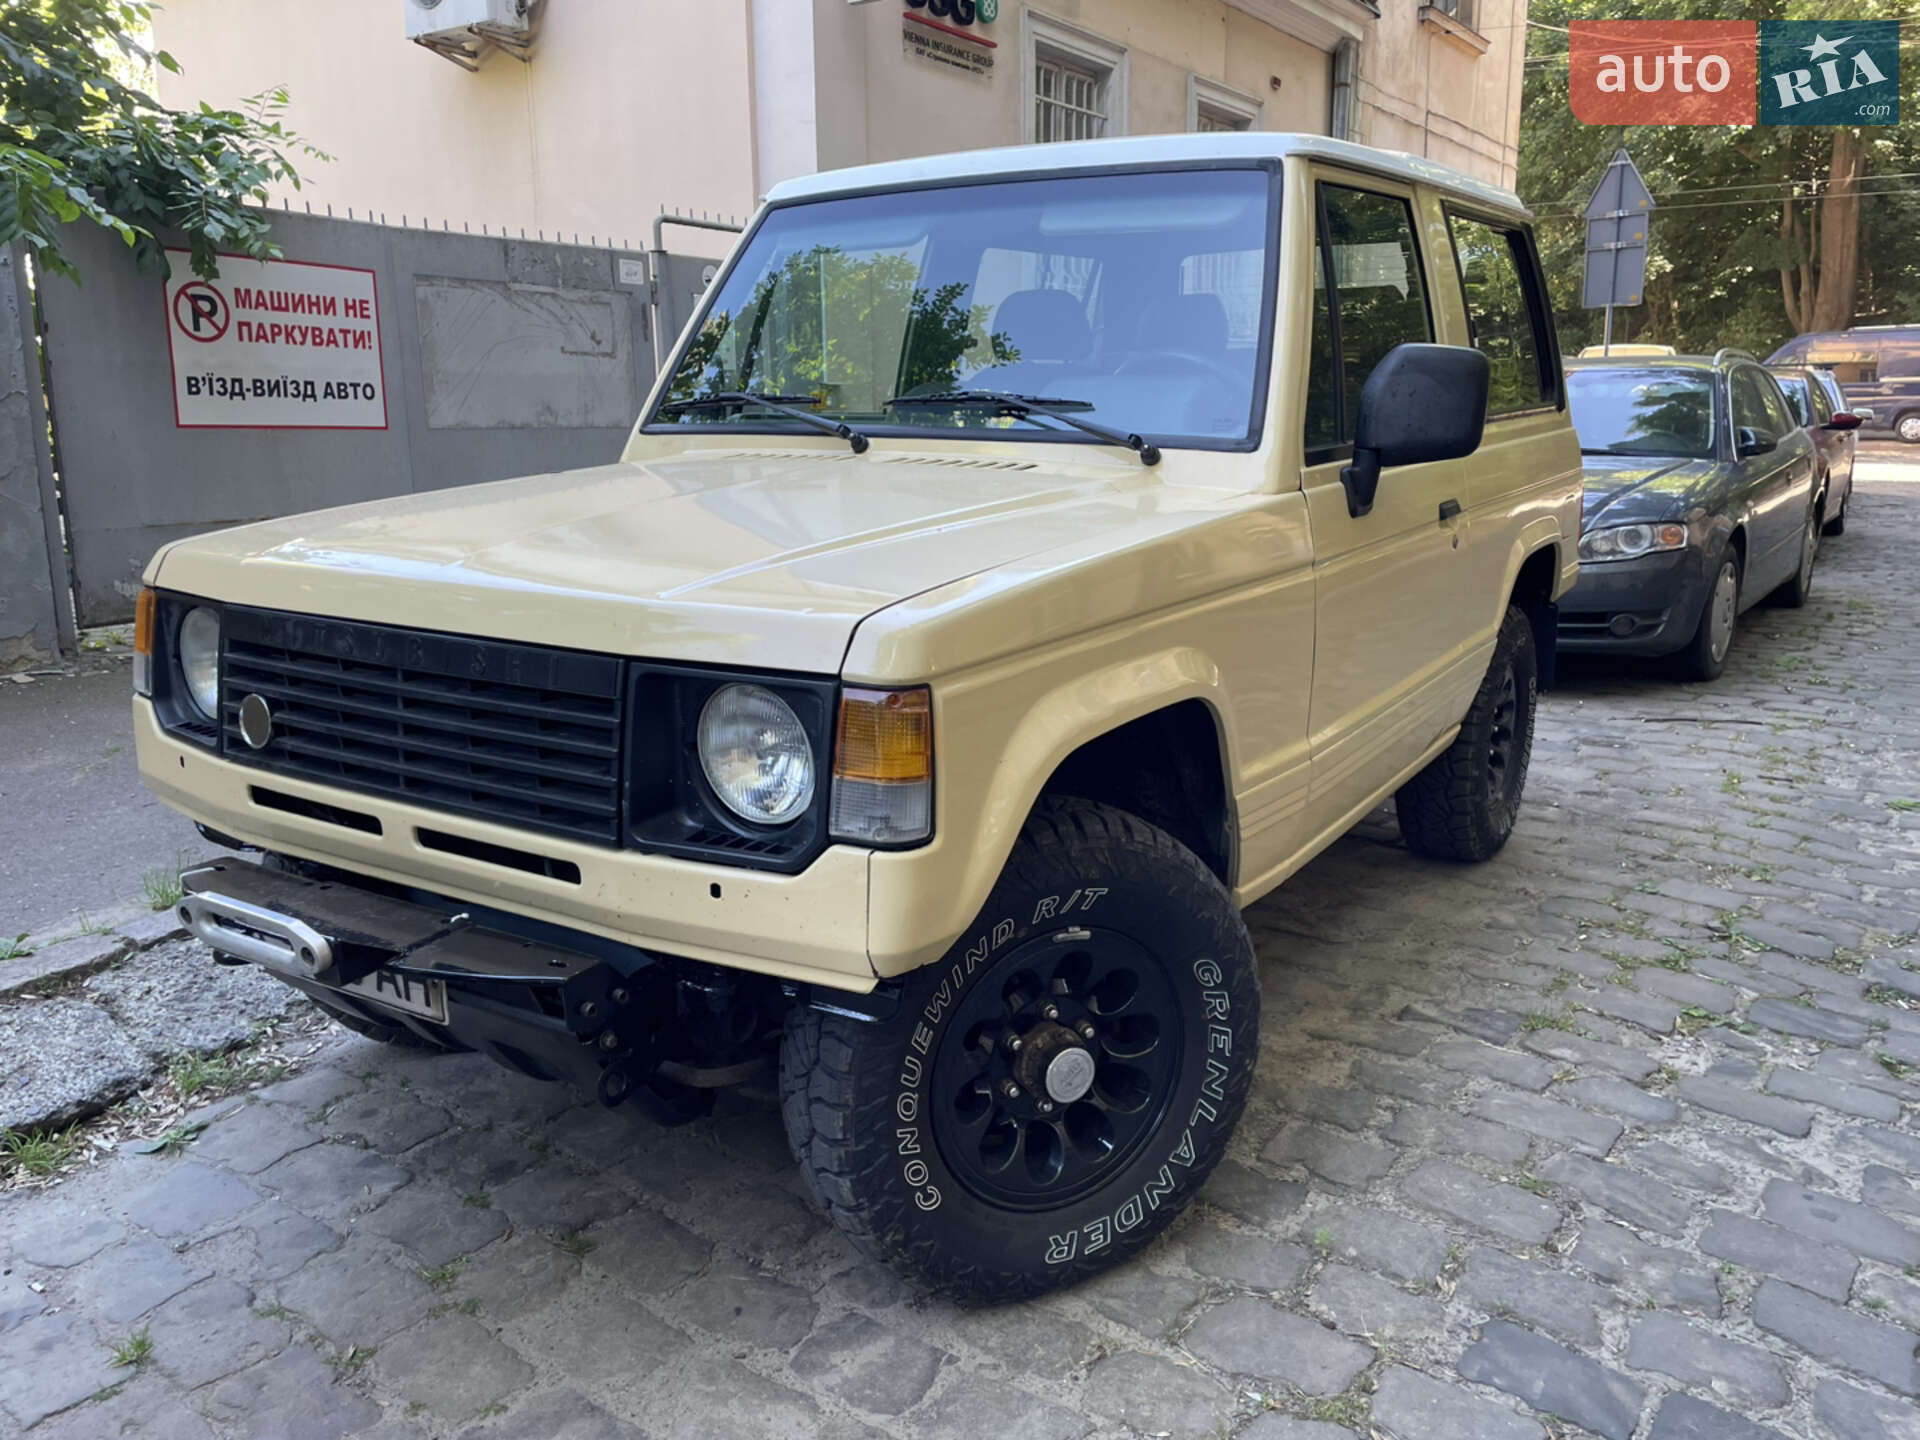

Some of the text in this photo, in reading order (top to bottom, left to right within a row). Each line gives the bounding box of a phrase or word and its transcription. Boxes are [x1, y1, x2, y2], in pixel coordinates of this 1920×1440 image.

[903, 28, 930, 48] VIENNA
[932, 39, 970, 61] INSURANCE
[971, 52, 994, 67] GROUP
[233, 287, 372, 320] МАШИНИ НЕ
[236, 320, 373, 350] ПАРКУВАТИ!
[322, 381, 376, 401] АВТО
[896, 888, 1108, 1212] CONQUEWIND R/T
[1044, 959, 1233, 1264] GRENLANDER
